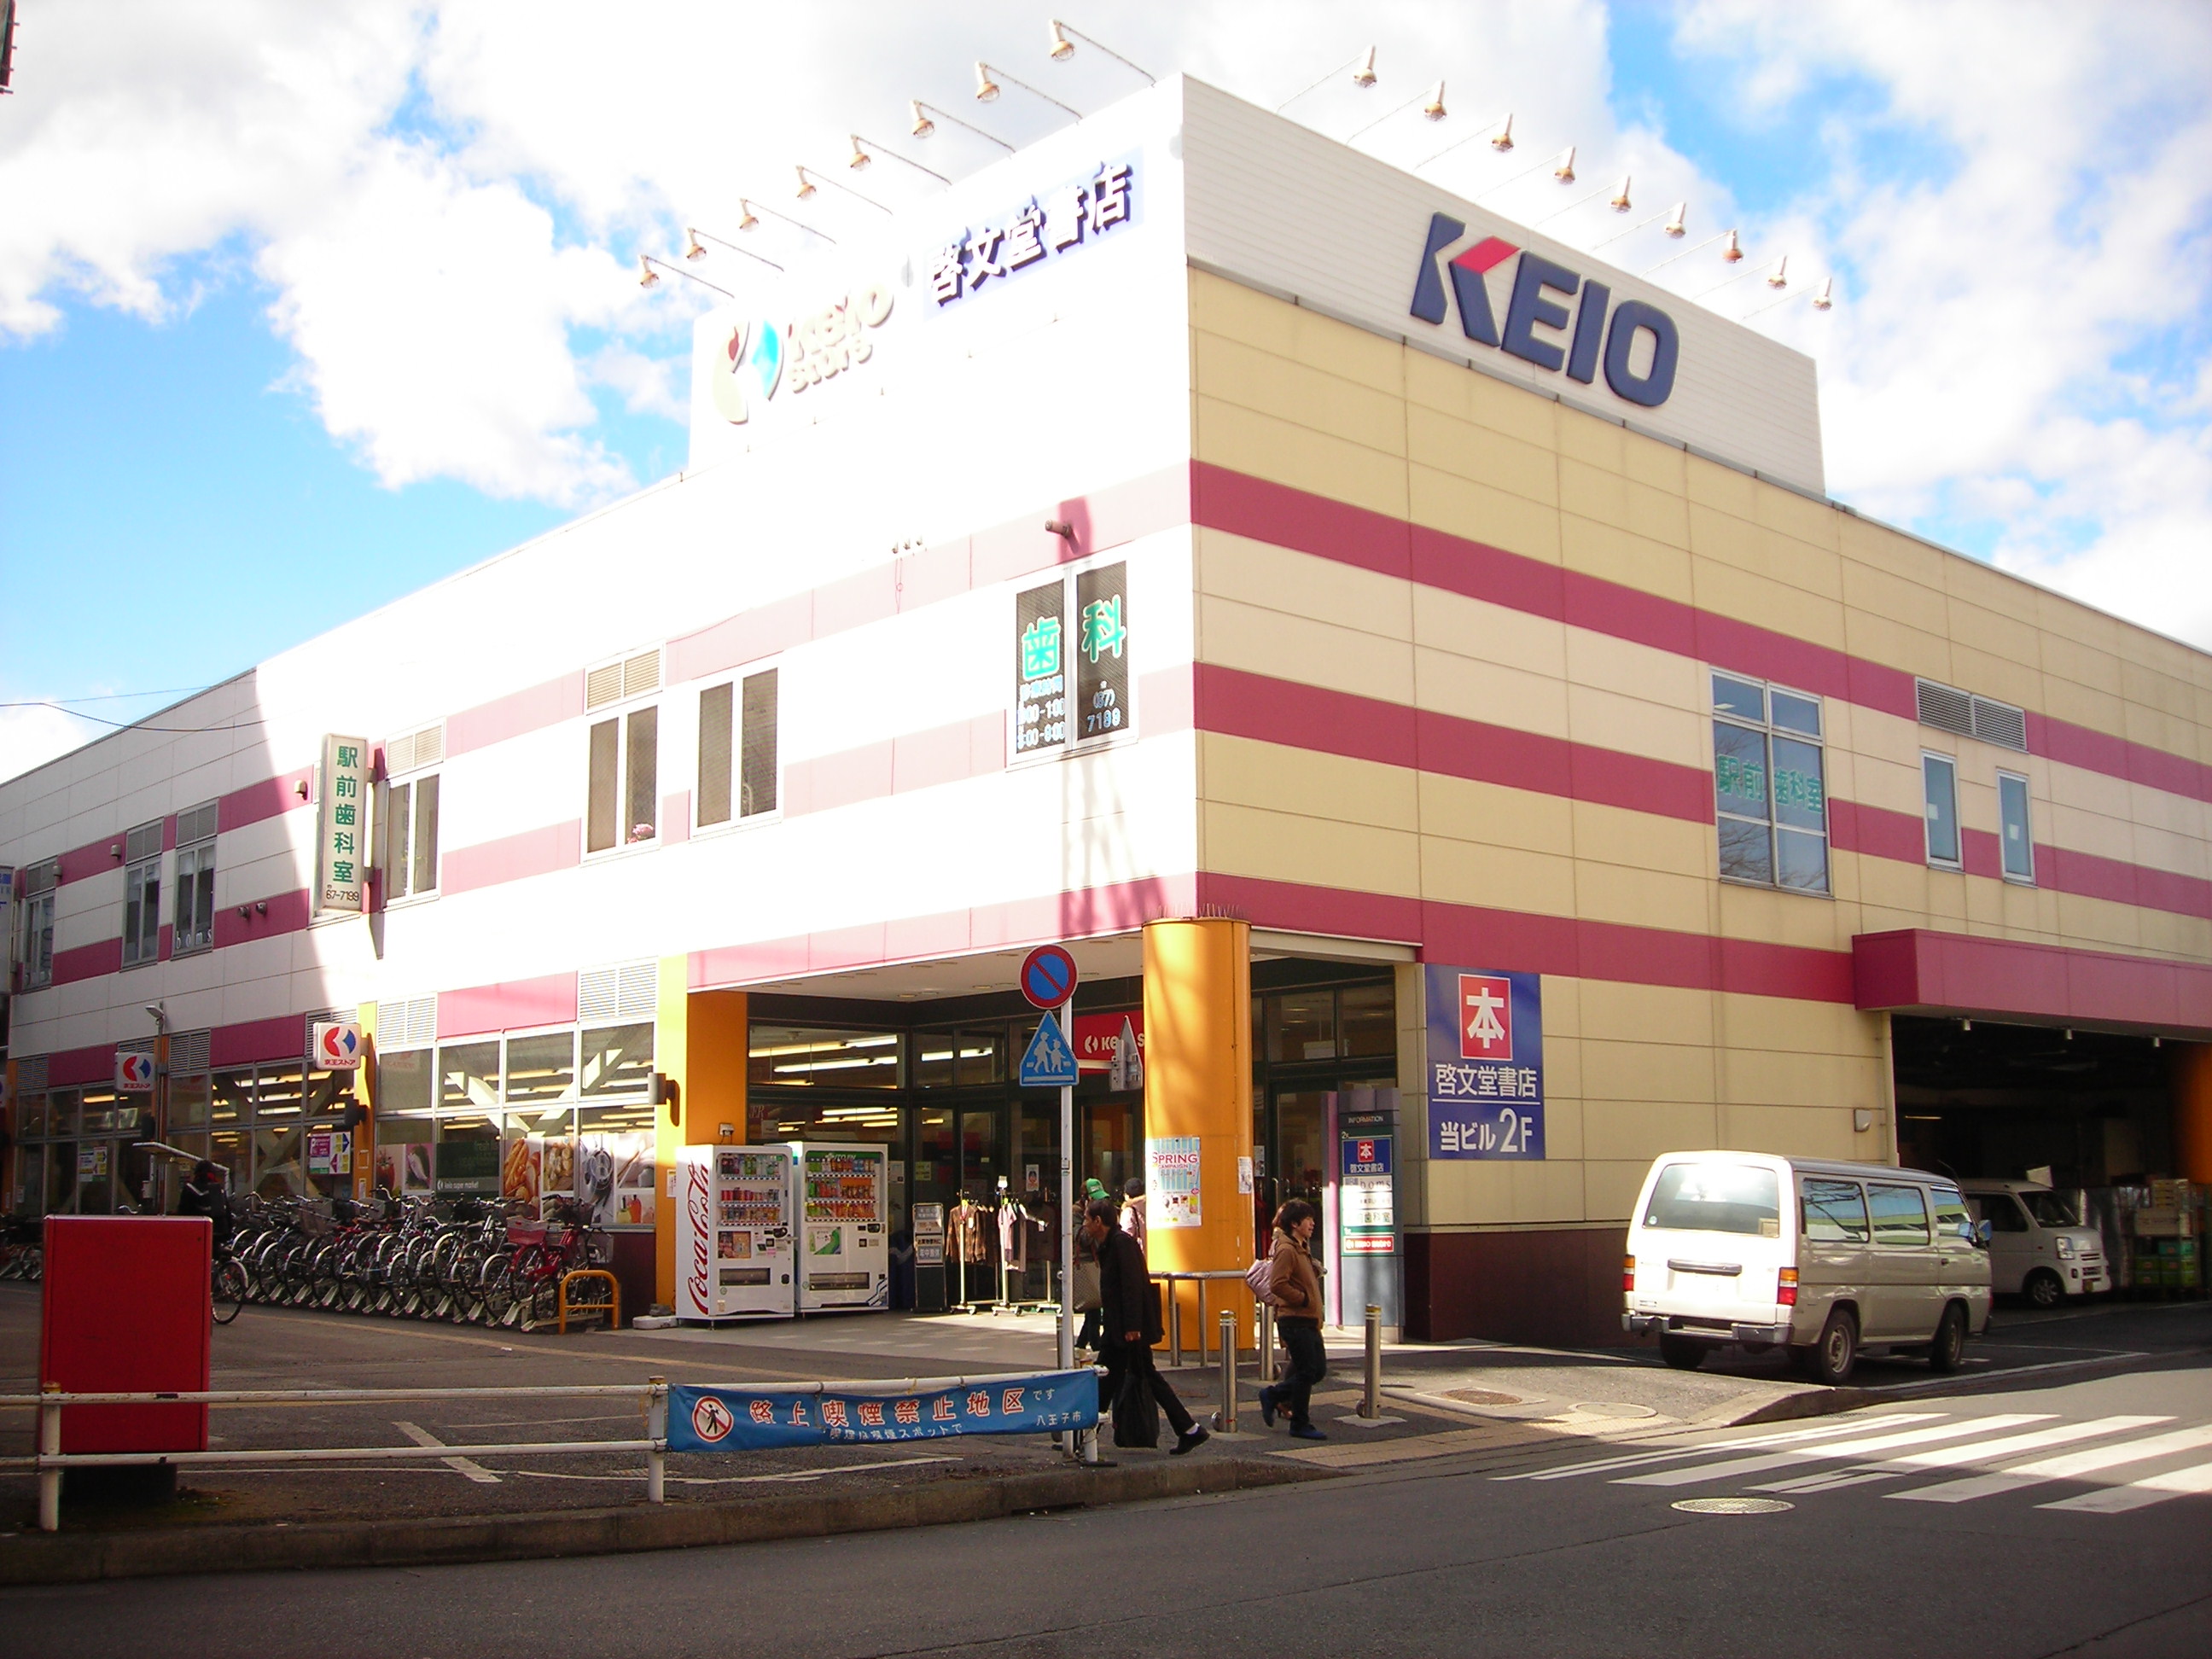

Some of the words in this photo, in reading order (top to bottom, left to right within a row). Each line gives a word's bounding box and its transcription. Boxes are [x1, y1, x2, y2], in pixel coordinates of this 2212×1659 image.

[929, 161, 1133, 307] 啓文堂書店
[1410, 211, 1679, 407] KEIO
[1022, 594, 1126, 682] 歯科
[1717, 754, 1823, 814] 駅前歯科室
[333, 745, 358, 884] 駅前歯科室
[1465, 987, 1505, 1049] 本
[1435, 1063, 1537, 1098] 啓文堂書店
[1348, 1115, 1384, 1124] INFORMATION
[1440, 1107, 1534, 1153] 当ビル2F
[1152, 1150, 1198, 1164] SPRING
[1359, 1143, 1372, 1159] 本
[749, 1387, 1025, 1428] 路上喫煙禁止地区
[1036, 1411, 1082, 1427] 八王子市
